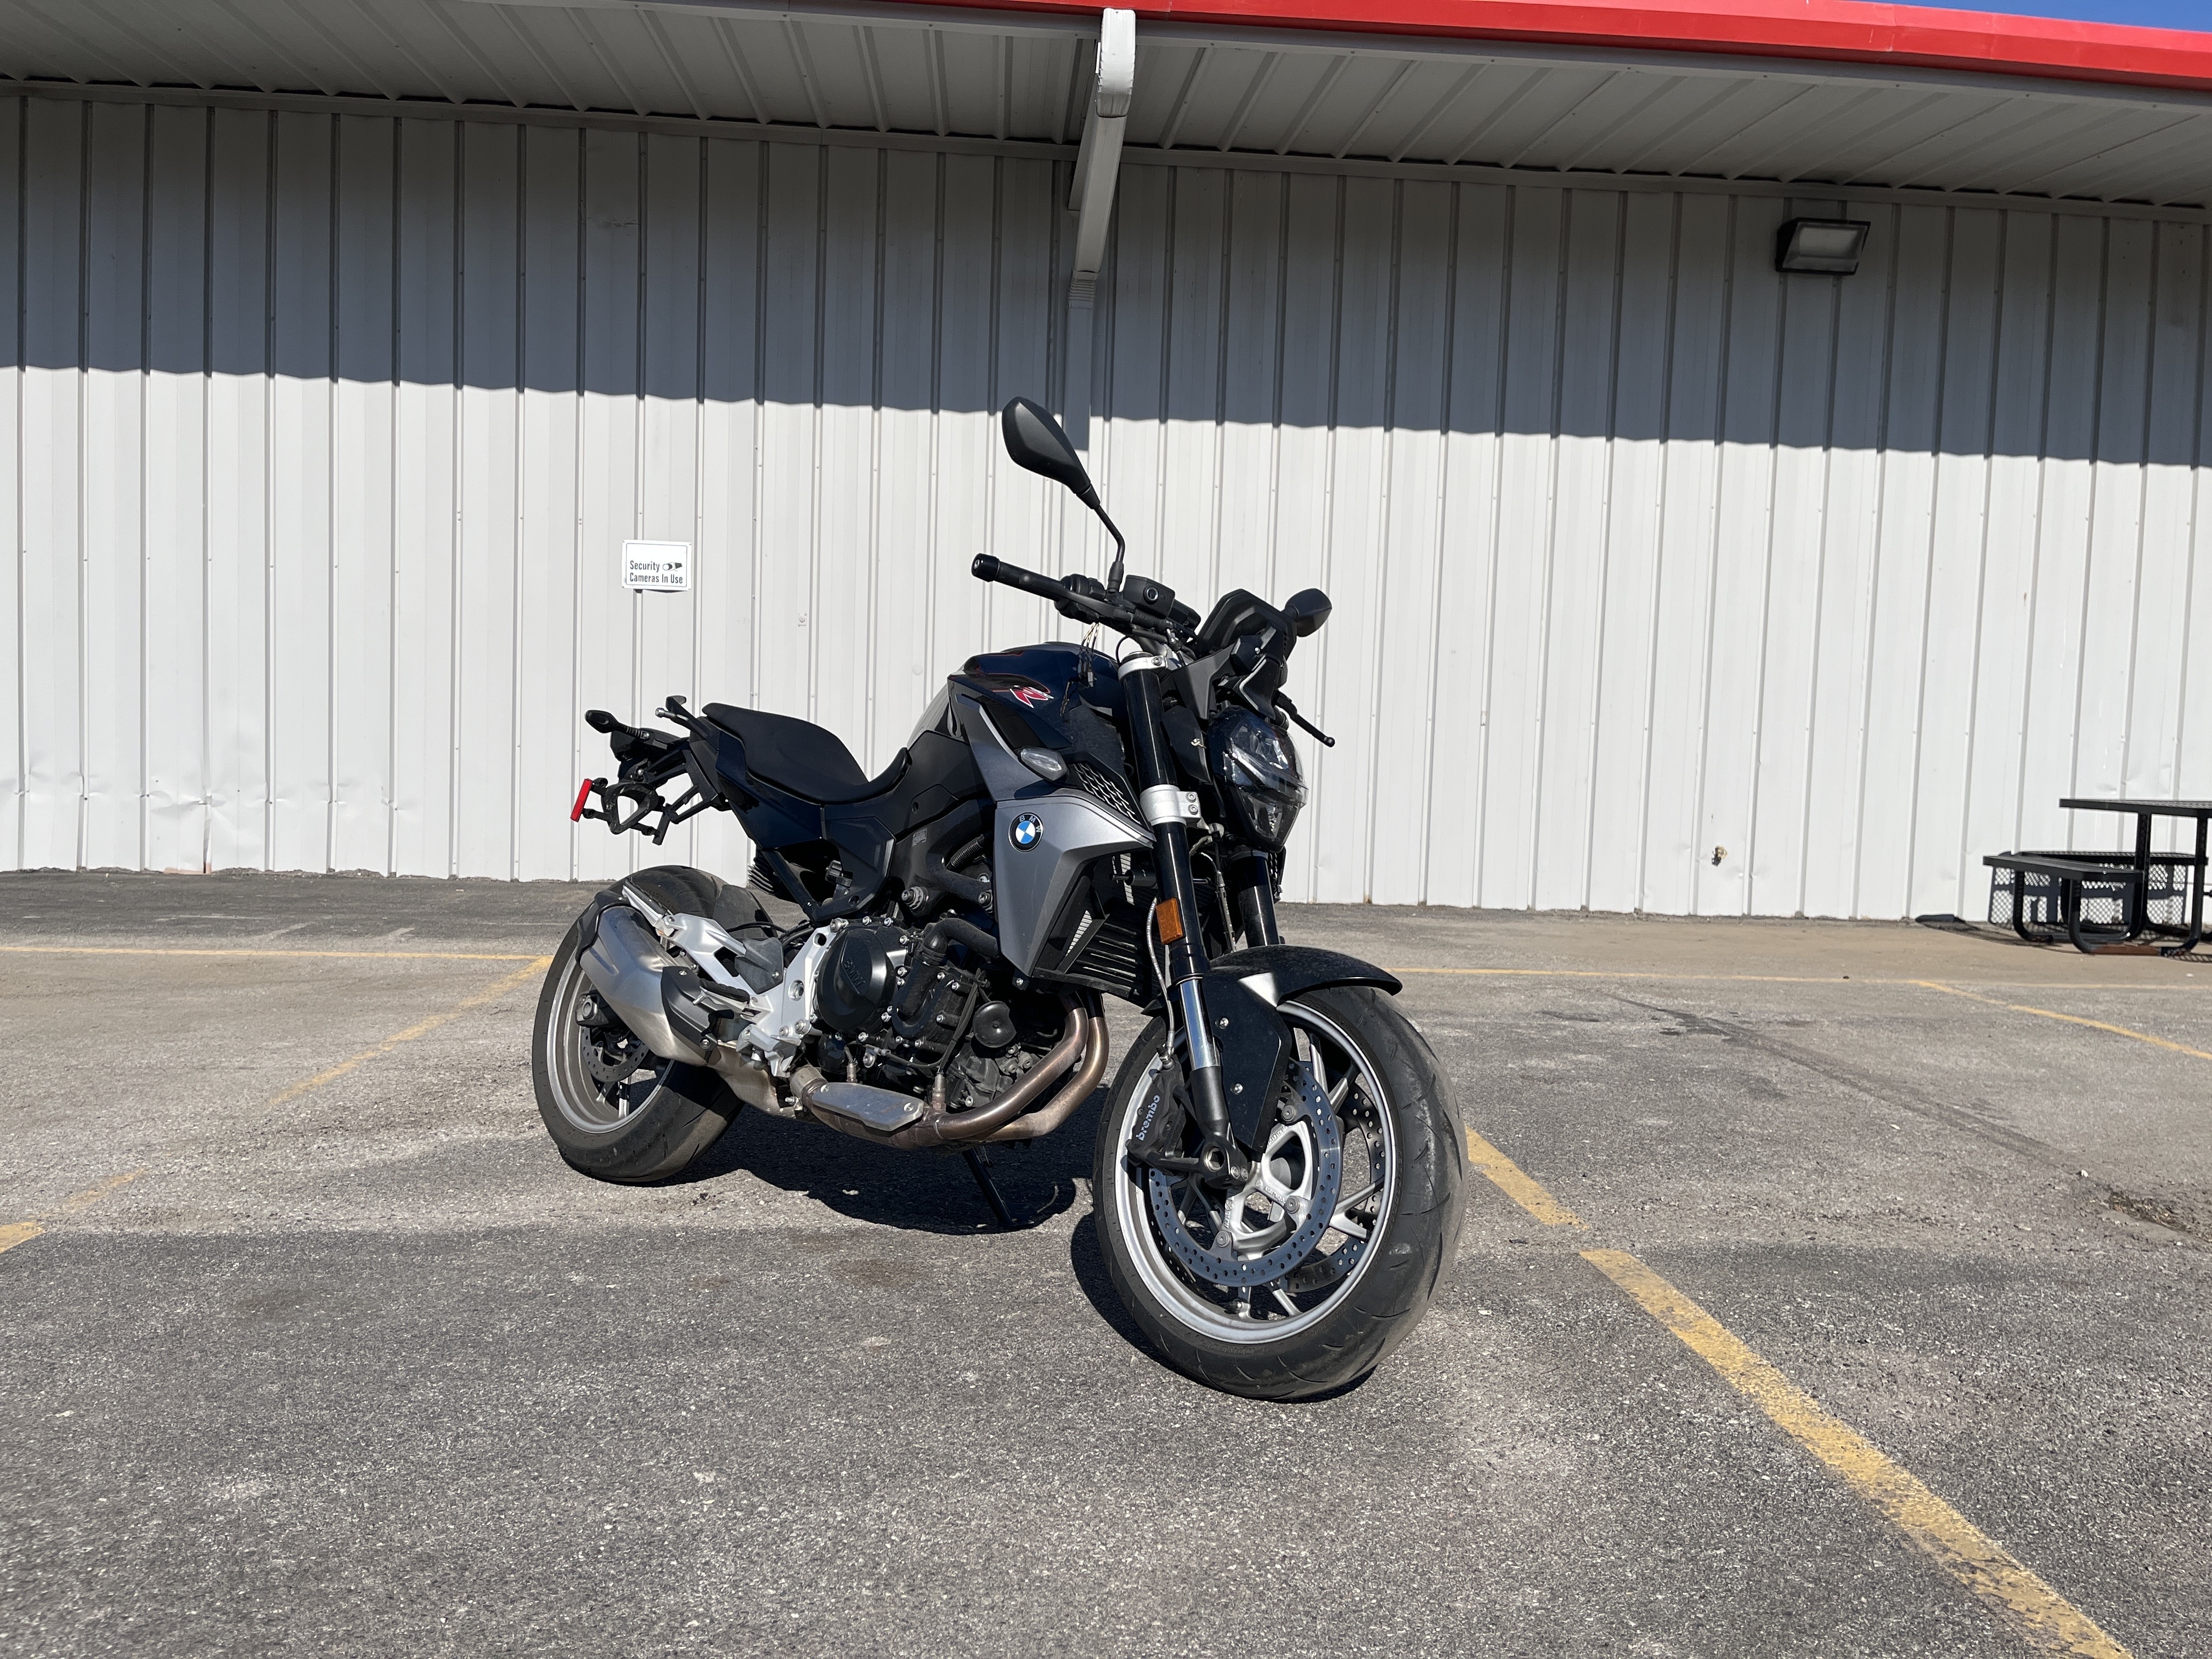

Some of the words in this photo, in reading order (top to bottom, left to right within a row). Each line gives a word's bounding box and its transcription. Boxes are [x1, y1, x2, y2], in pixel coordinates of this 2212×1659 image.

[630, 560, 660, 573] Security
[630, 572, 659, 583] Cameras
[662, 574, 668, 583] In
[670, 574, 683, 584] Use
[1019, 815, 1041, 833] BMW
[1136, 1094, 1160, 1141] brembo
